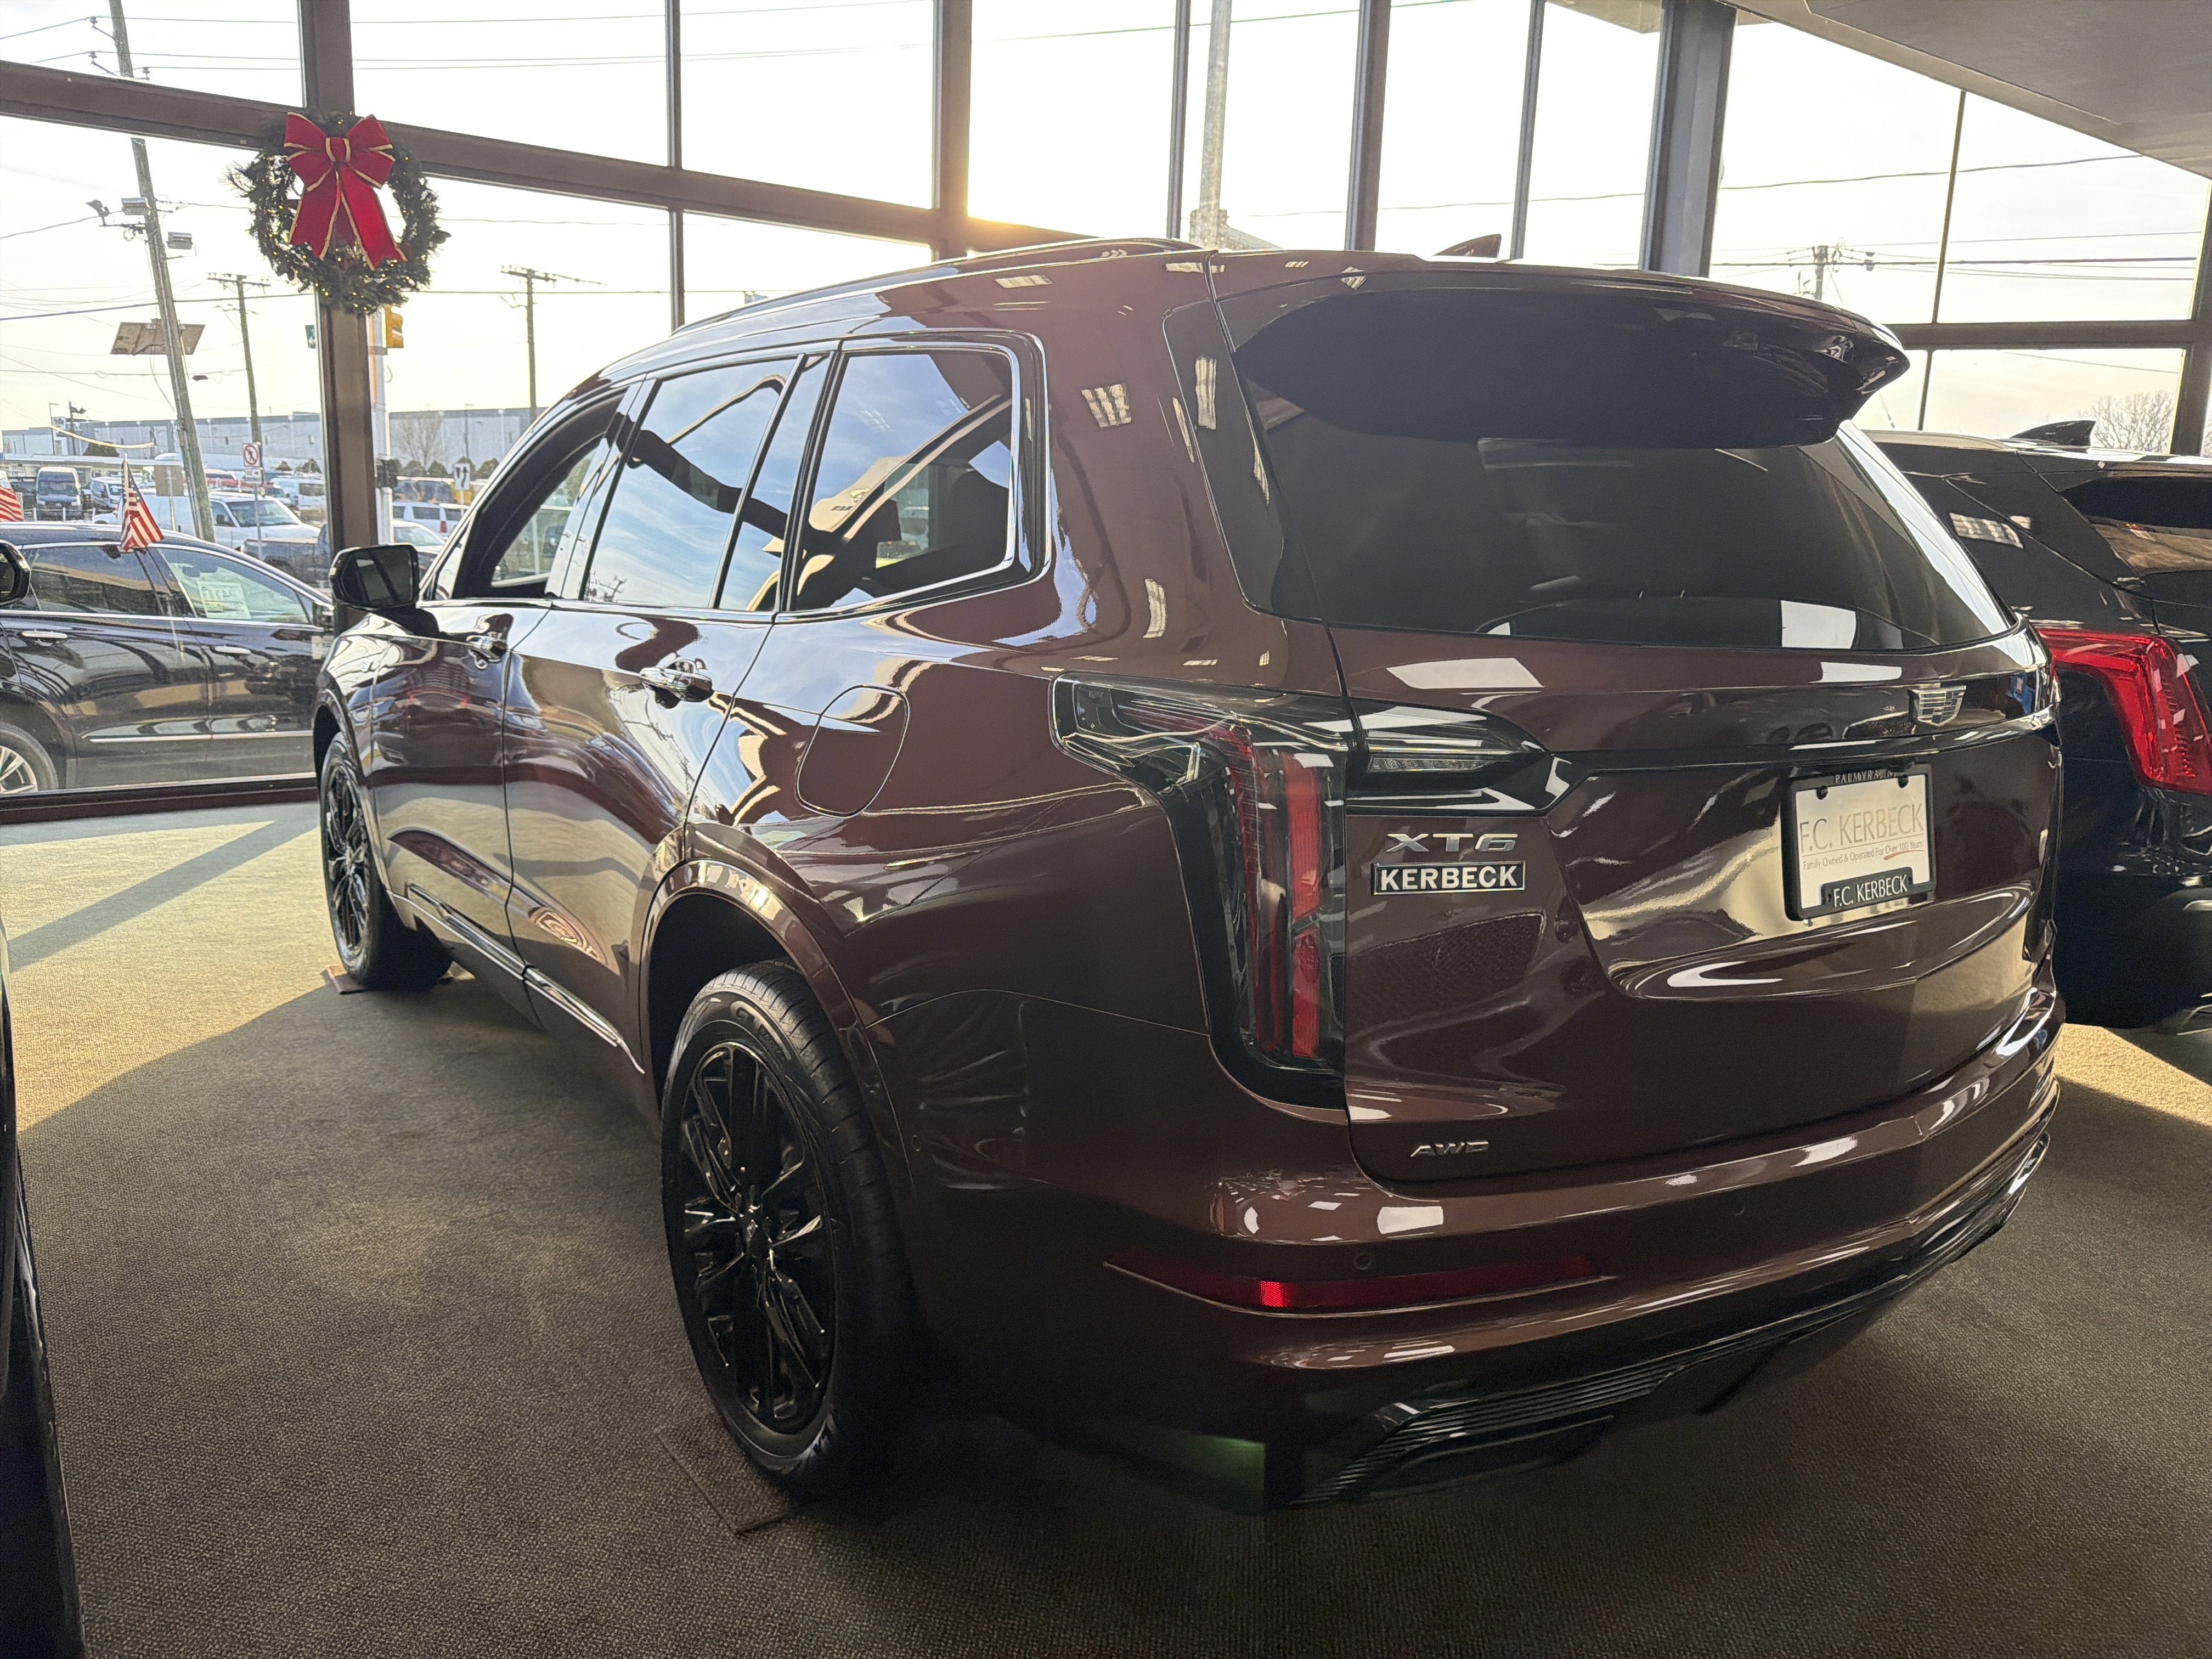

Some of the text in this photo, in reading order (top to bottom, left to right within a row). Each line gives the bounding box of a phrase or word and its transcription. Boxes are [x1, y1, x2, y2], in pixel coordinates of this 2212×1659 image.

[1799, 803, 1925, 853] F.C. KERBECK
[1386, 833, 1518, 852] XT6
[1803, 840, 1923, 870] Family Owned & Operated For Over 100 Years
[1381, 865, 1518, 891] KERBECK
[1833, 874, 1908, 908] F.C. KERBECK
[1410, 1141, 1489, 1158] AWD
